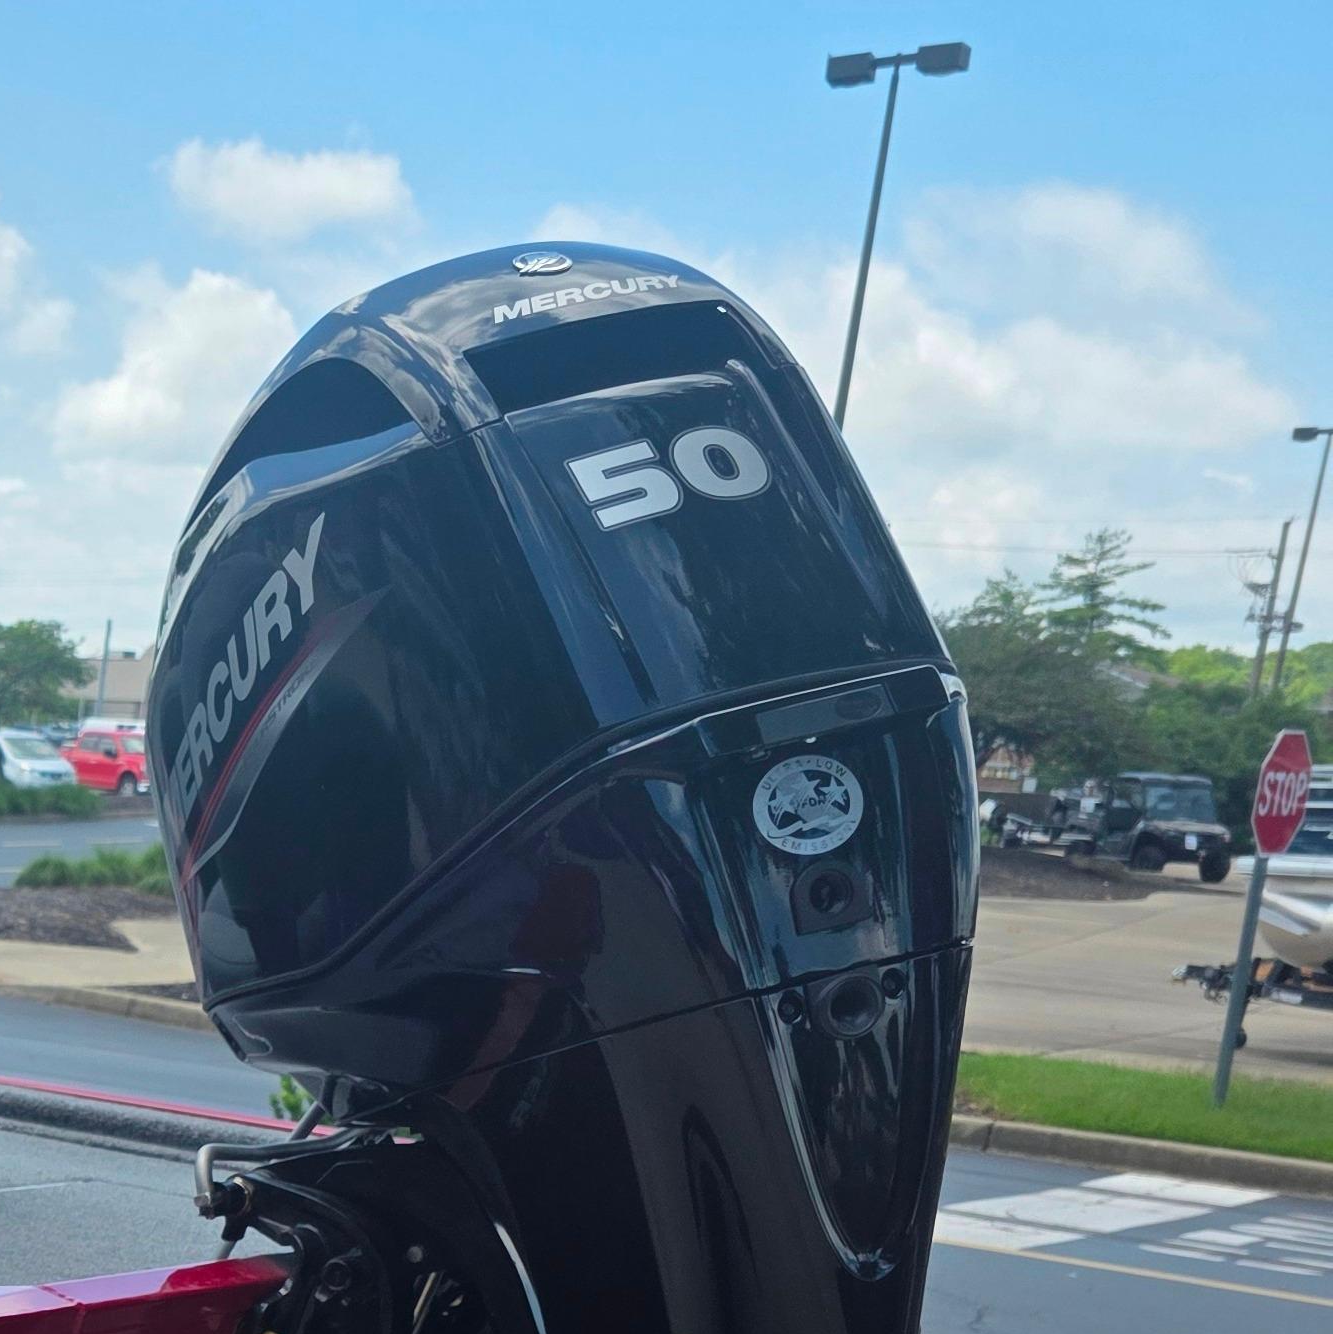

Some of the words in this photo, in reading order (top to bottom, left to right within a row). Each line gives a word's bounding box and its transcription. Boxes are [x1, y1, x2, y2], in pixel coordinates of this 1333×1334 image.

[493, 274, 679, 324] MERCURY
[564, 425, 772, 531] 50
[164, 511, 325, 846] MERCURY
[816, 758, 848, 777] LOW
[1258, 771, 1308, 817] STOP
